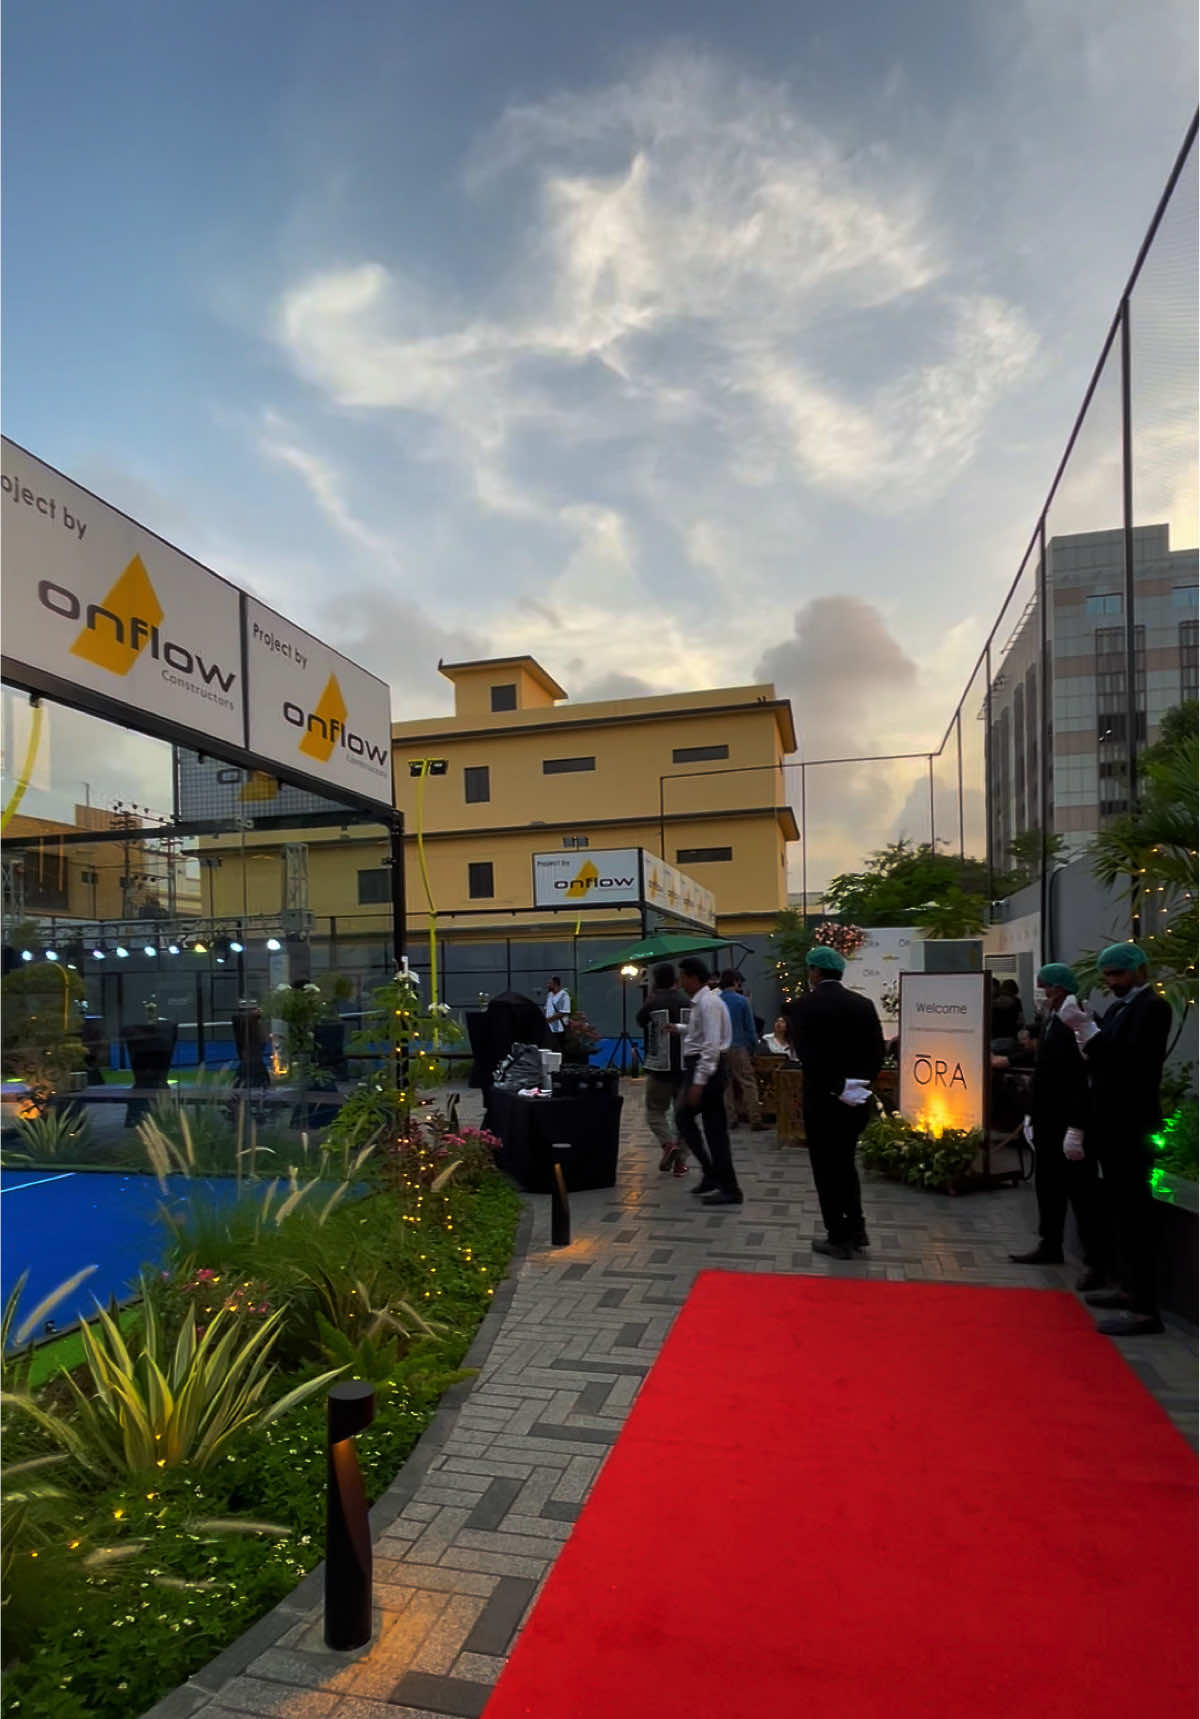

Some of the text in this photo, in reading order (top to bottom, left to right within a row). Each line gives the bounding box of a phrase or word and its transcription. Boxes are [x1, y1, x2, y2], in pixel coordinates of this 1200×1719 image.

[63, 505, 87, 540] by
[38, 579, 236, 693] onflow
[252, 623, 308, 670] Project by
[160, 668, 235, 711] Constructors
[283, 701, 388, 766] onflow
[554, 877, 634, 889] onflow
[916, 1002, 968, 1015] Welcome
